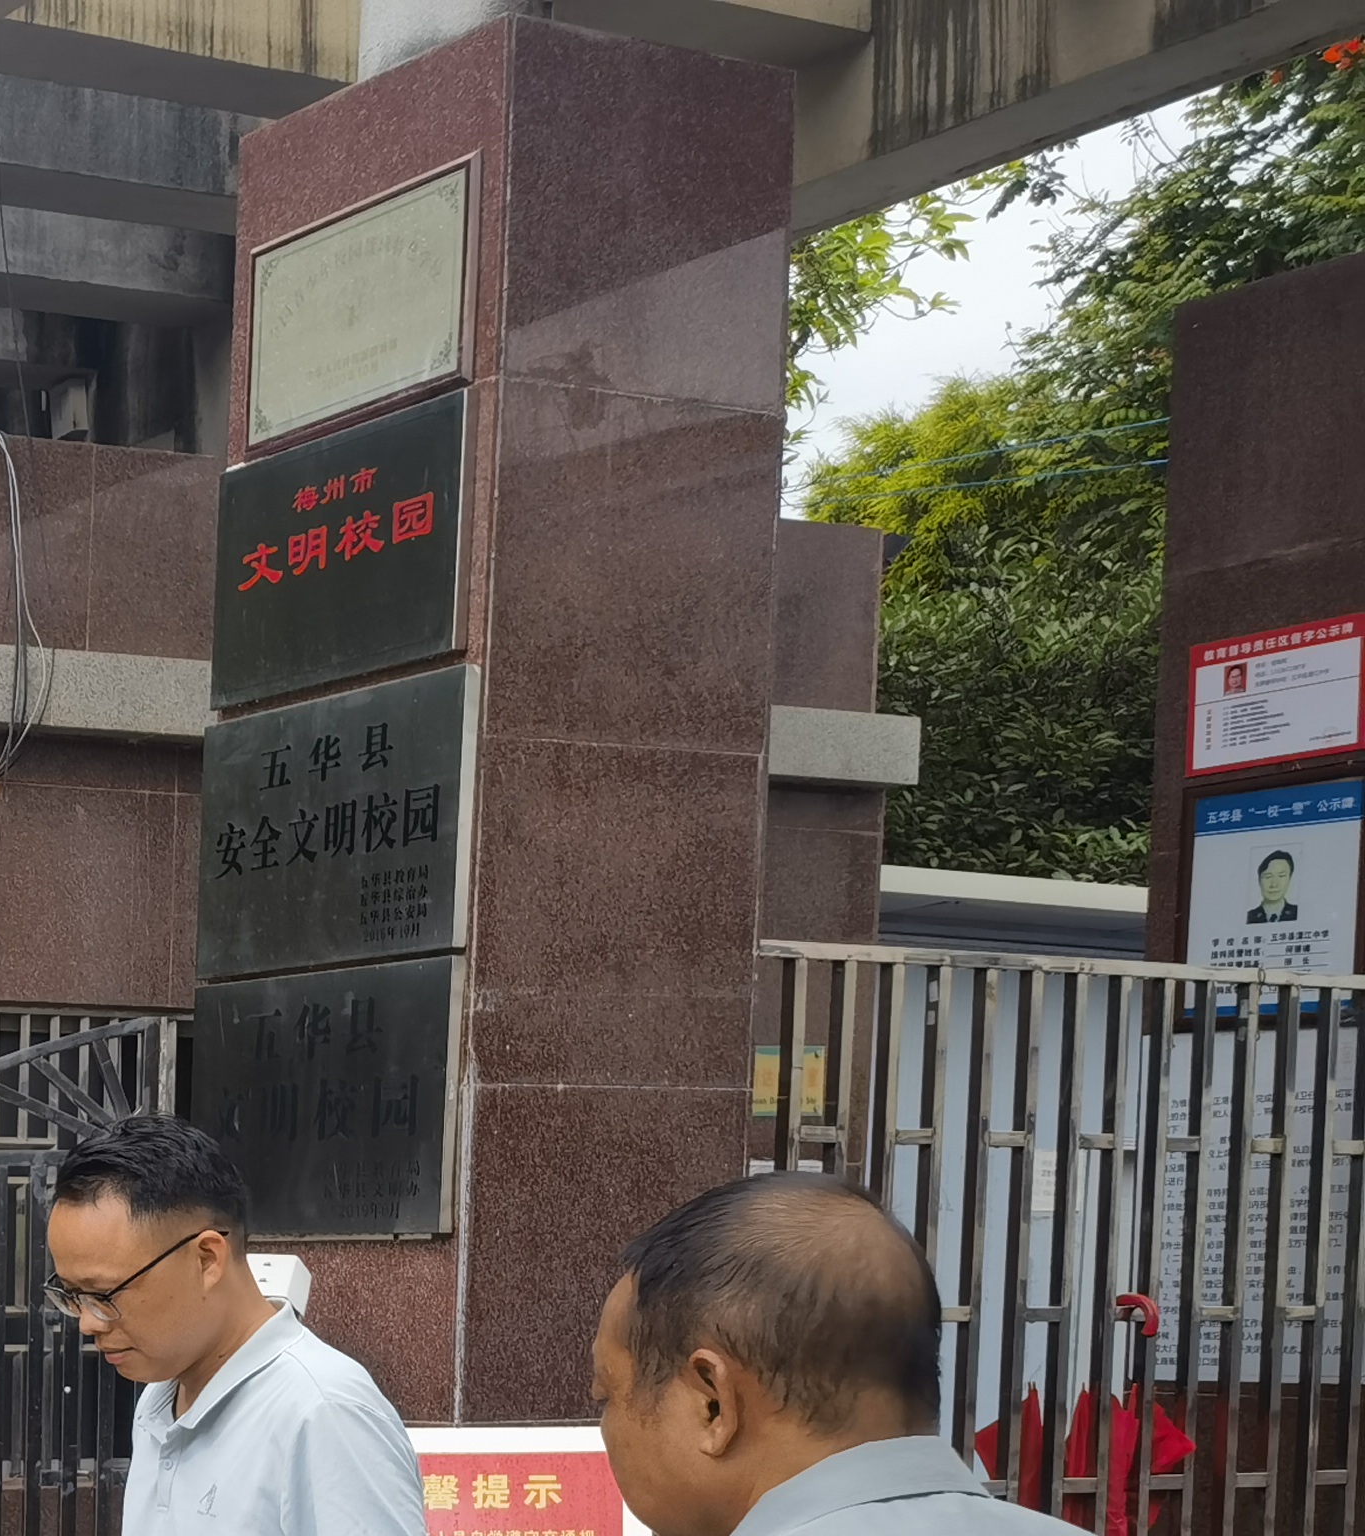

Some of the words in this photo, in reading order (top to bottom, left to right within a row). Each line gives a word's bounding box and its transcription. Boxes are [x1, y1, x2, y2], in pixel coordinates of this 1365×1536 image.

[292, 467, 378, 513] 梅州市
[237, 491, 435, 592] 文明校园
[259, 722, 394, 791] 五华县
[215, 783, 441, 880] 安全文明校园
[244, 996, 384, 1060] 五华县
[216, 1074, 420, 1142] 文明校园
[422, 1473, 562, 1510] 馨提示
